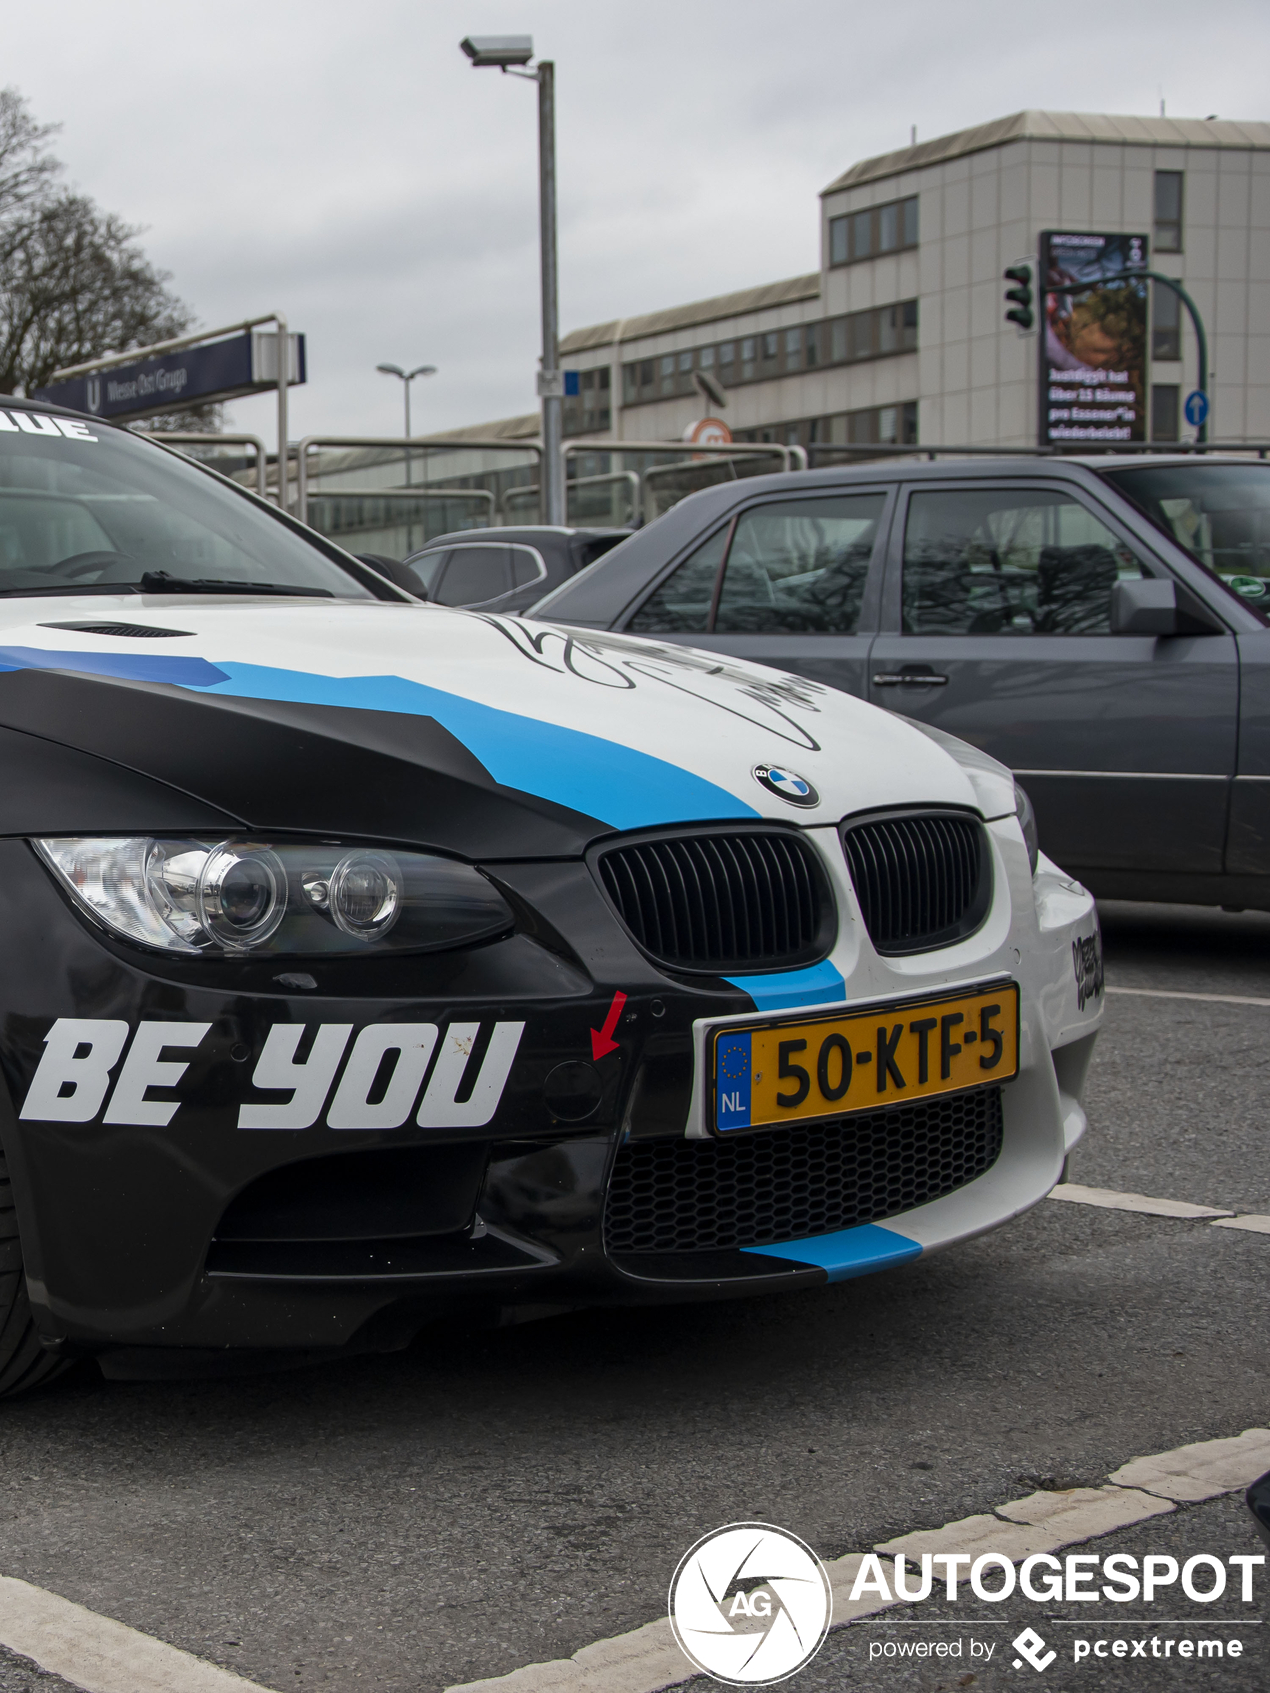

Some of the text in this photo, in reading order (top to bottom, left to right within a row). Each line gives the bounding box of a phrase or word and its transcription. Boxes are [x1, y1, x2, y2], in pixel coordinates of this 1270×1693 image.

[86, 378, 101, 413] U
[107, 379, 138, 402] Messe
[18, 1017, 526, 1129] BE YOU
[776, 1004, 1004, 1108] 50-KTF-5
[721, 1091, 746, 1113] NL
